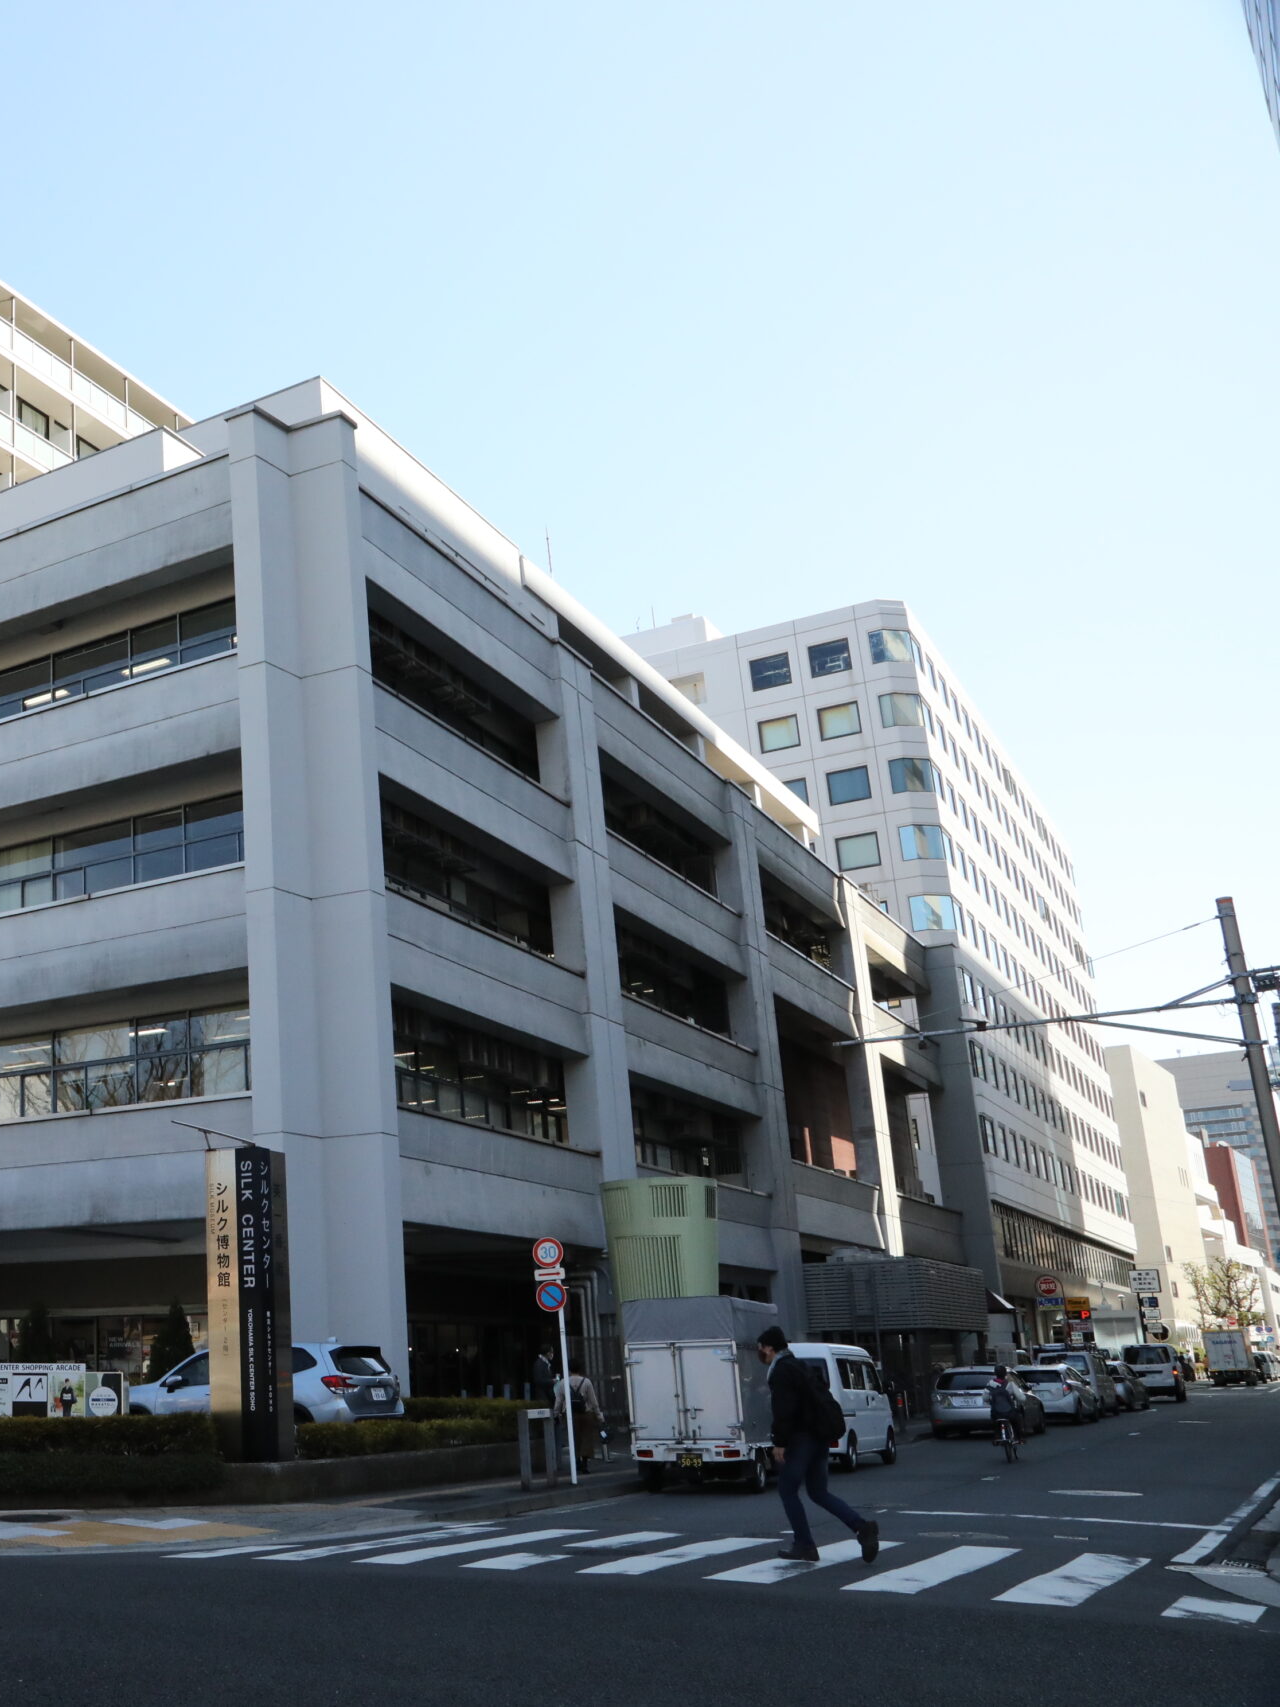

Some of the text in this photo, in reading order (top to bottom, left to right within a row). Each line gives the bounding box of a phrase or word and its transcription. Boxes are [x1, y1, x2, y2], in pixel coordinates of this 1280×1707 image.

[216, 1182, 231, 1287] シルク博物館
[240, 1160, 256, 1288] SILK CENTER
[260, 1161, 271, 1289] シルクセンター
[540, 1246, 557, 1259] 30
[1081, 1310, 1090, 1319] P
